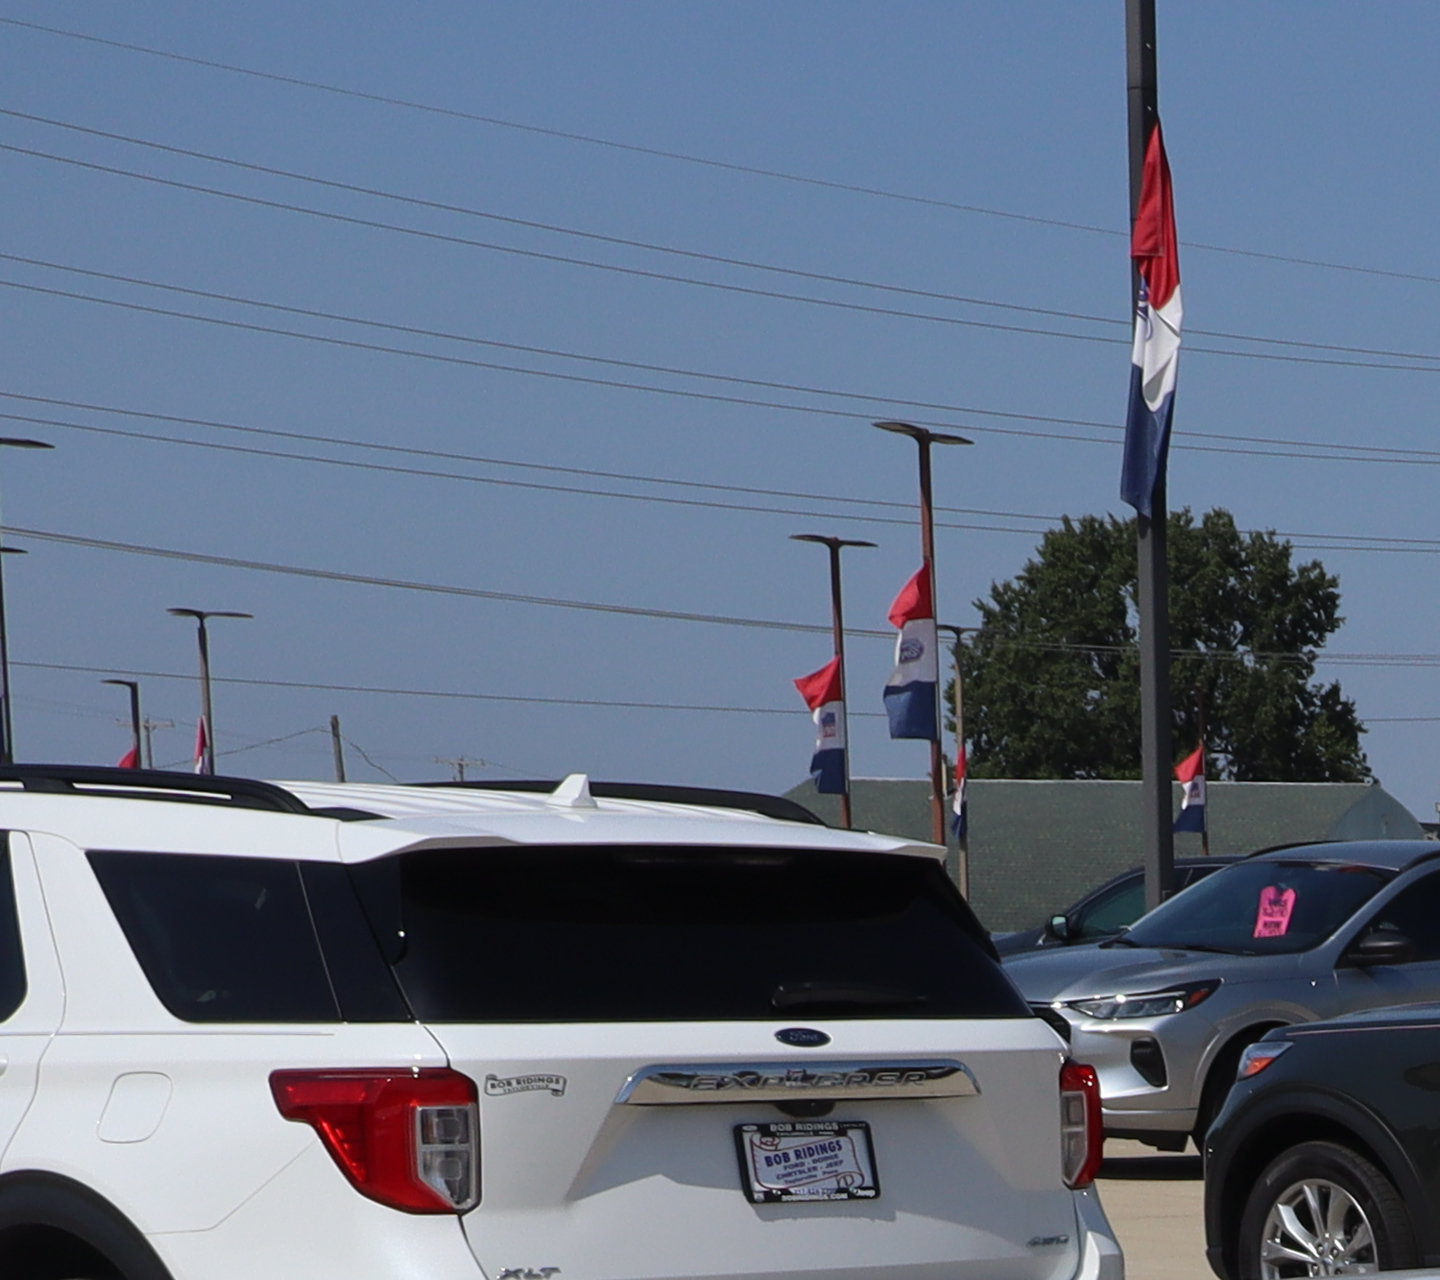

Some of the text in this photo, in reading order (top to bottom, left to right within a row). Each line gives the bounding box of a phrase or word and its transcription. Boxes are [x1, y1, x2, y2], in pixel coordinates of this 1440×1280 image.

[770, 1123, 793, 1132] BOB
[795, 1122, 839, 1131] RIDINGS
[764, 1139, 843, 1168] BOB RIDINGS
[497, 1267, 562, 1280] XLT
